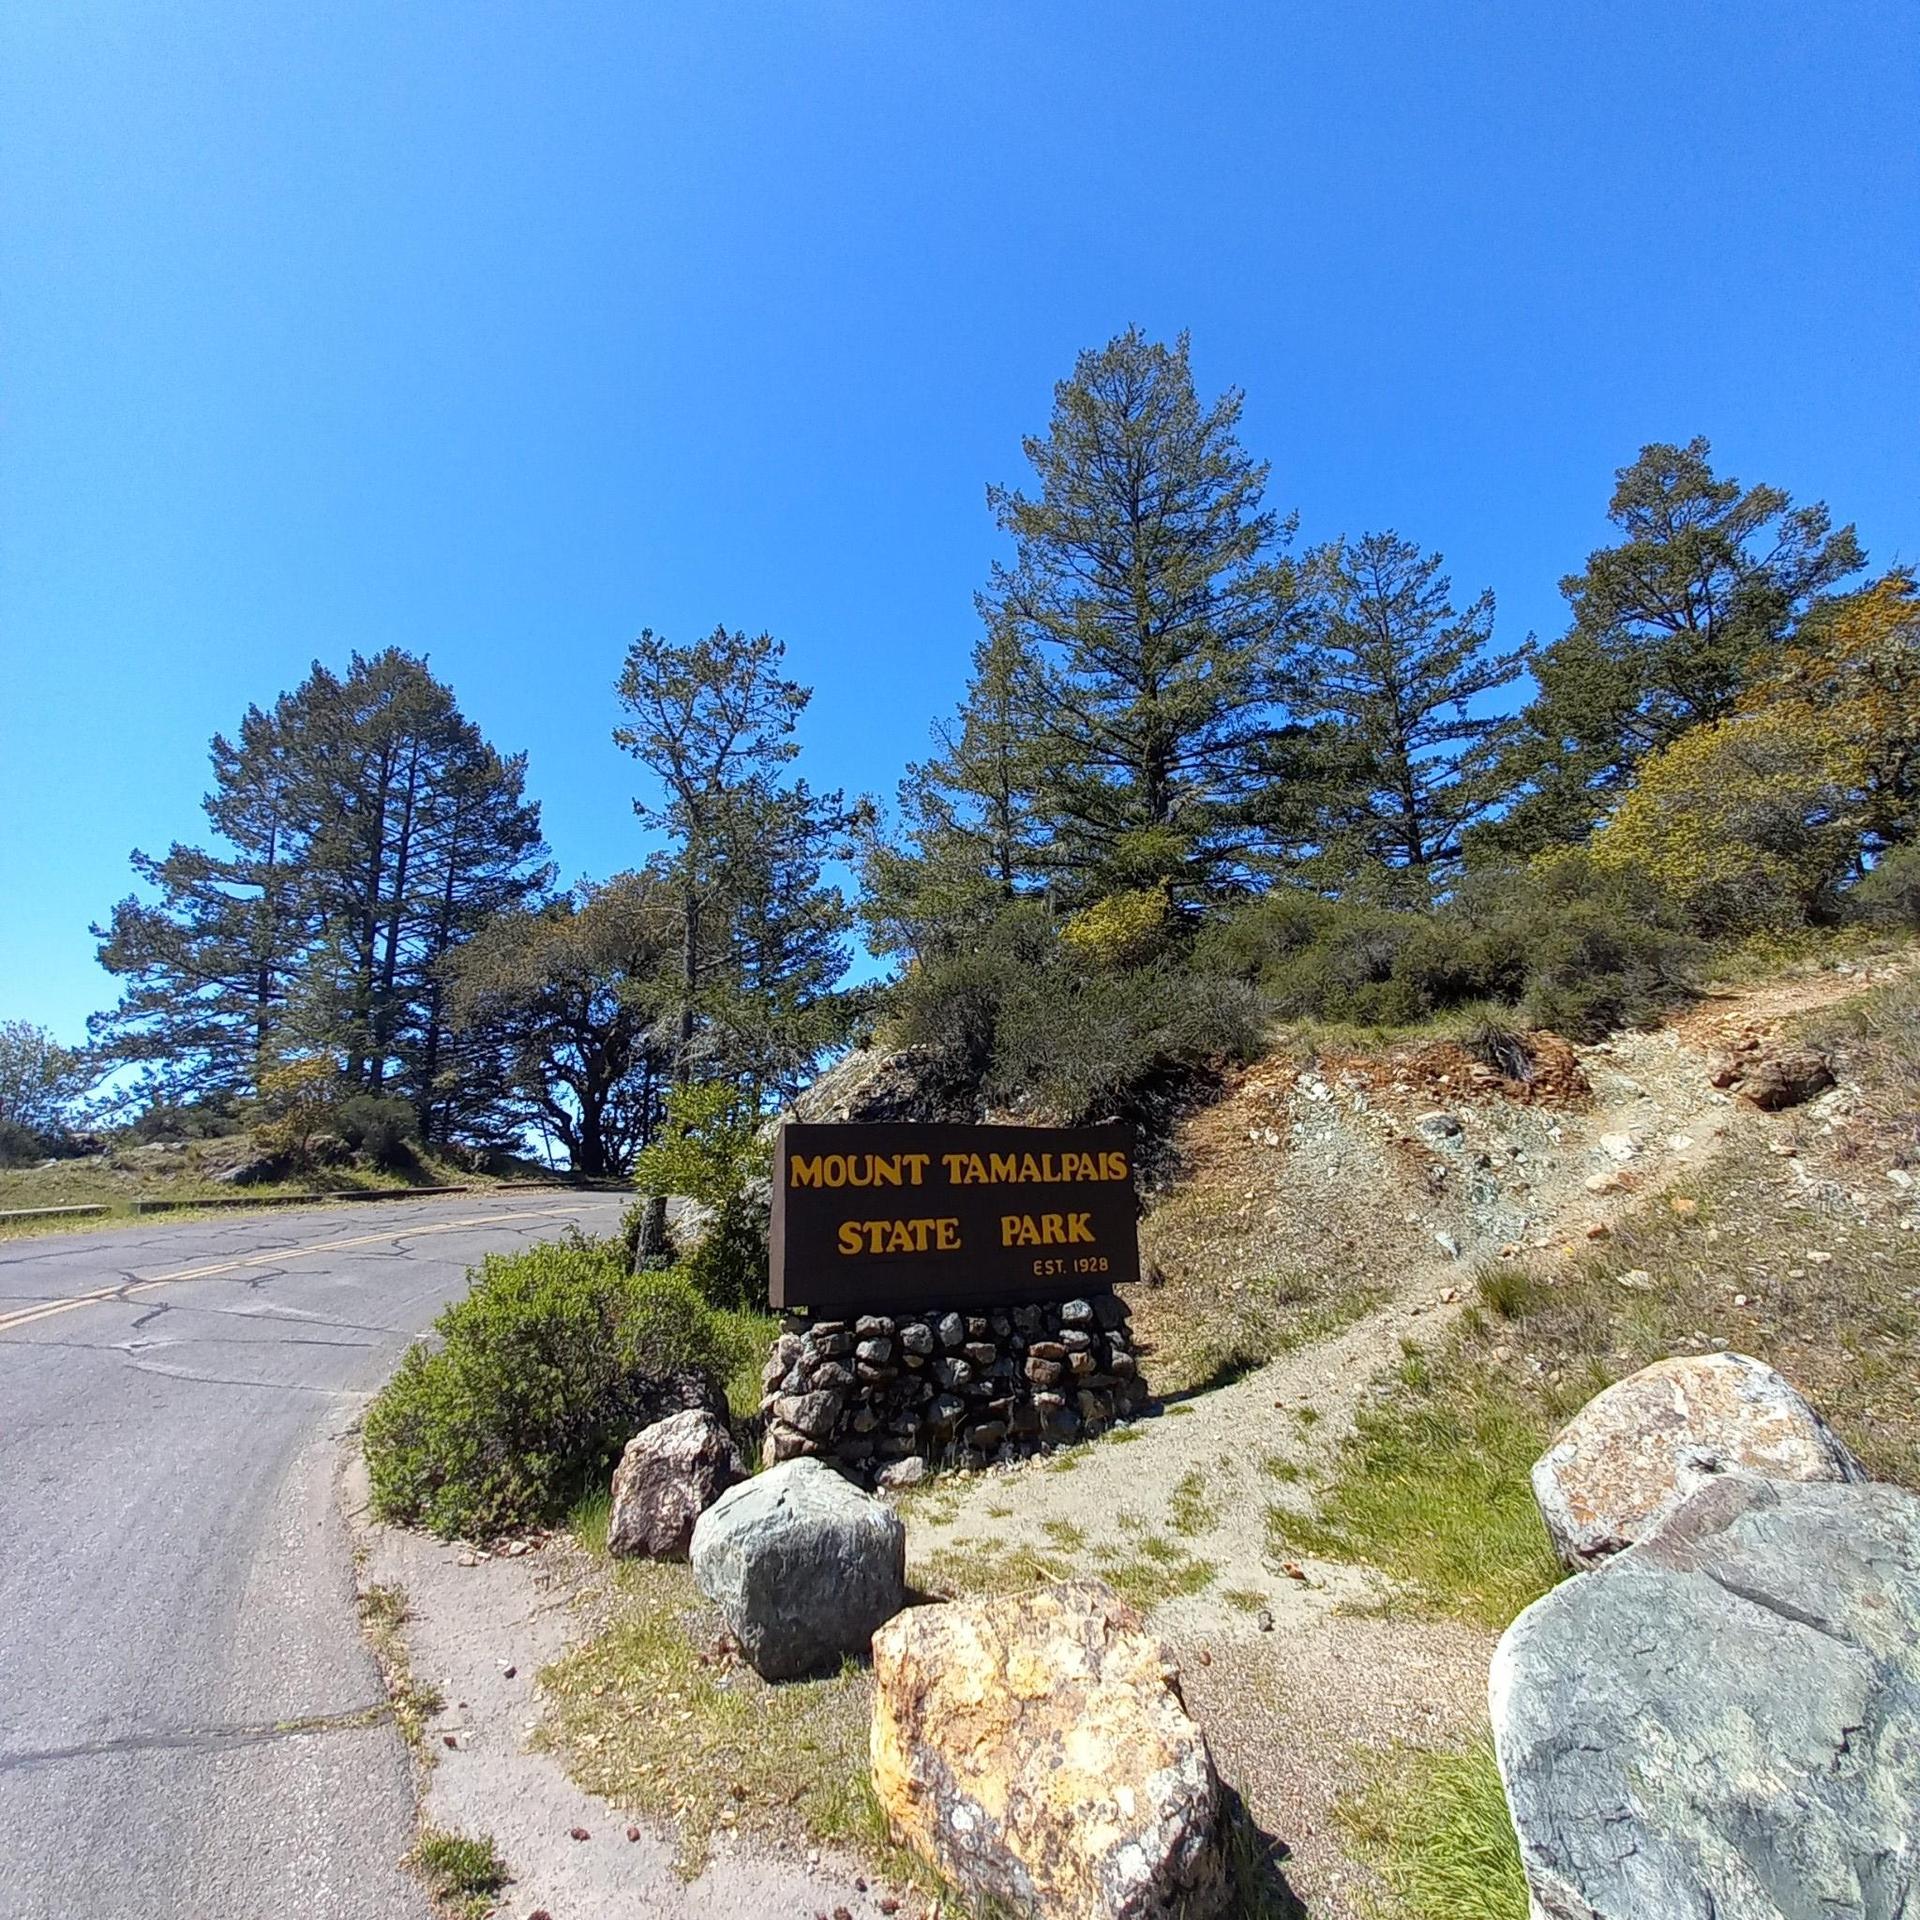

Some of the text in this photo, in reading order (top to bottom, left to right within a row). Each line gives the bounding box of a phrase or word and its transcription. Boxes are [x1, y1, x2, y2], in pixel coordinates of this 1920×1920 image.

[790, 1151, 1128, 1187] MOUNT TAMALPAIS
[837, 1213, 1095, 1254] STATE PARK
[1033, 1256, 1109, 1276] EST. 1928
